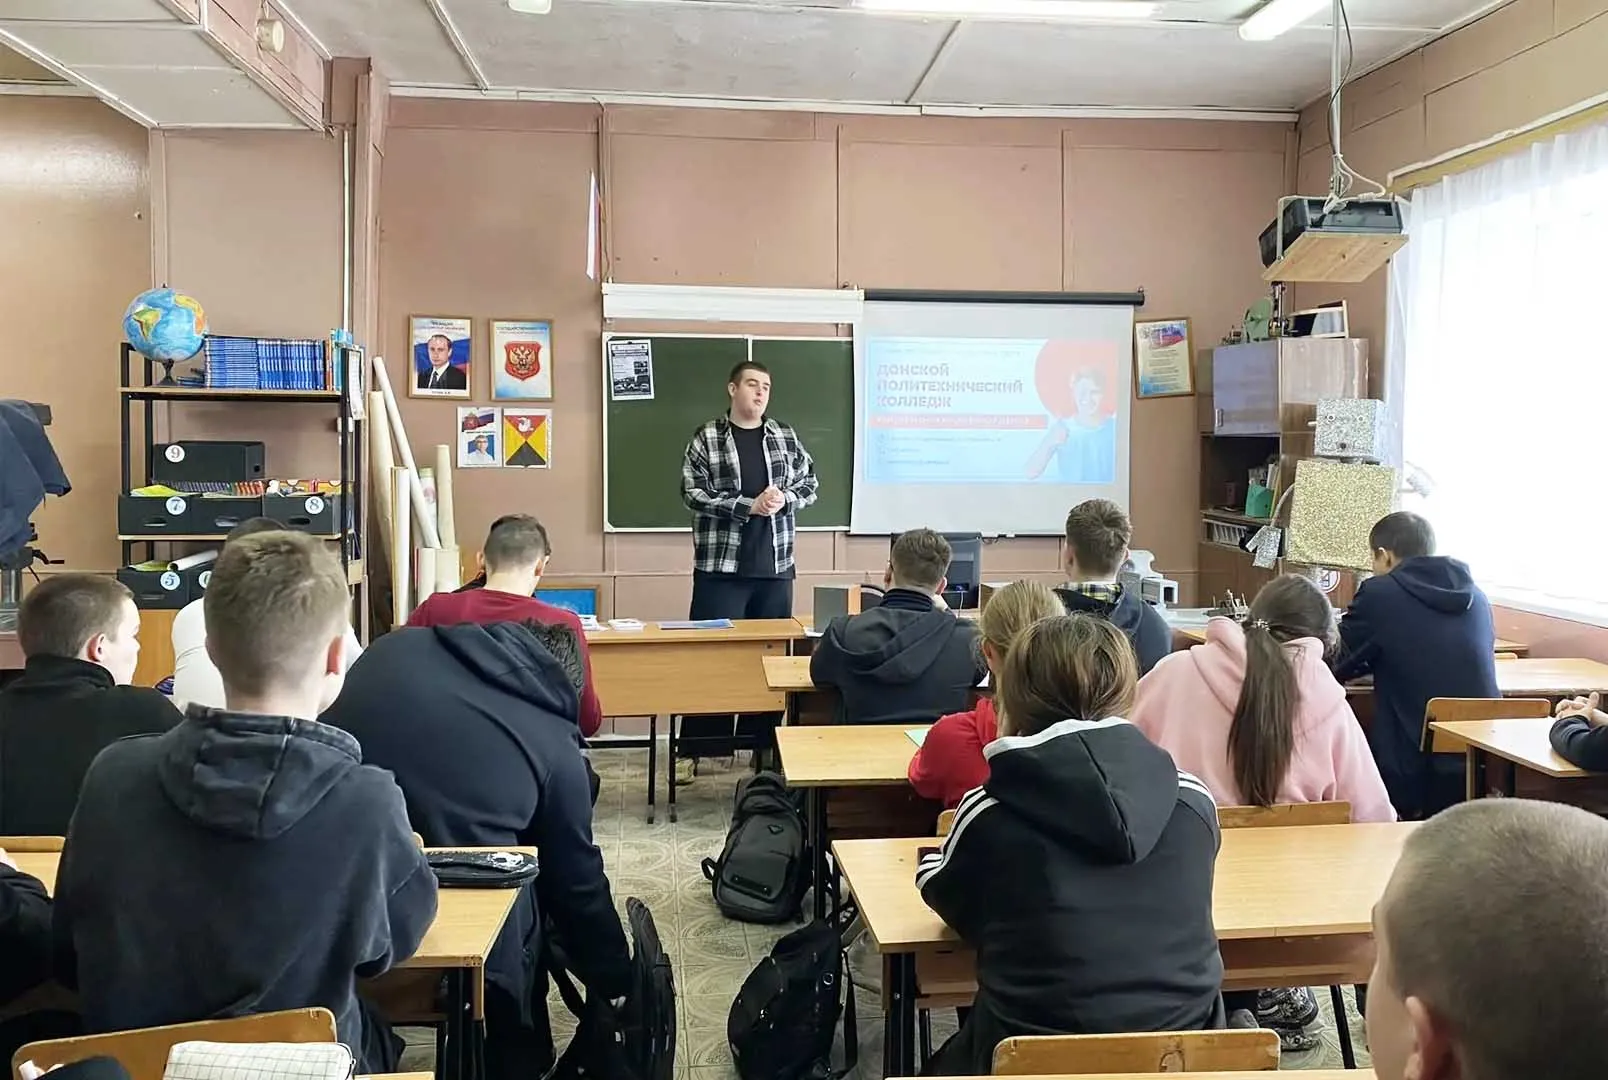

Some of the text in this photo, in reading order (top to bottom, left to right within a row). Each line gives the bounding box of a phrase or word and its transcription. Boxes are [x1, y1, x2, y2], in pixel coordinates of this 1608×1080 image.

[877, 364, 950, 377] ДОНСКОЙ
[877, 379, 1023, 393] ПОЛИТЕХНИЧЕСКИЙ
[877, 395, 952, 409] КОЛЛЕДЖ
[171, 446, 181, 459] 9
[171, 498, 181, 511] 7
[309, 498, 320, 511] 8
[165, 574, 175, 587] 5
